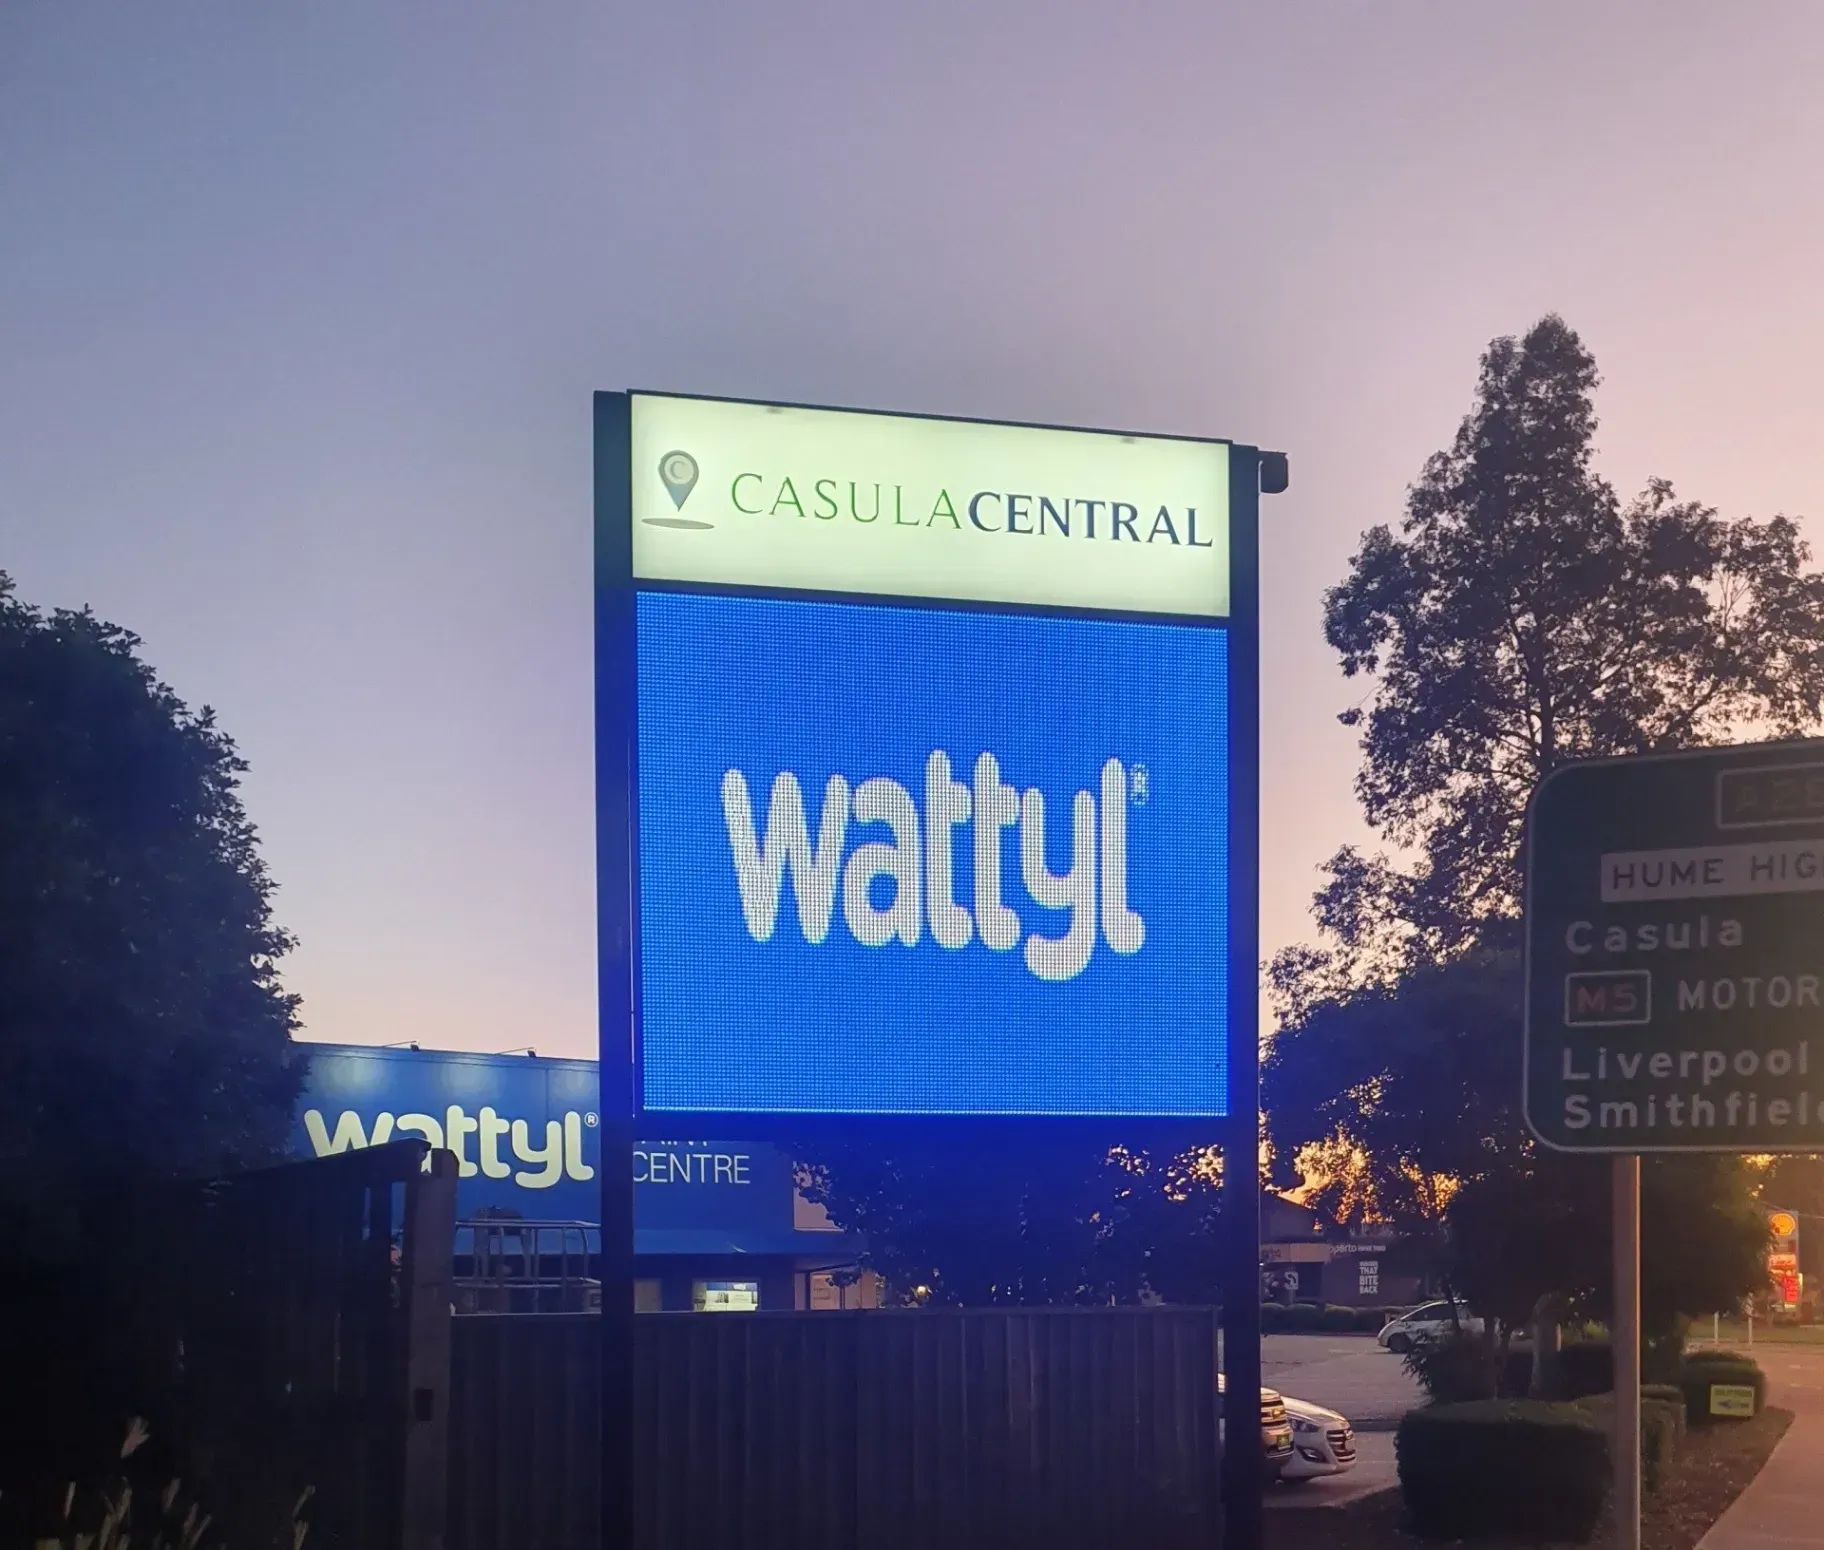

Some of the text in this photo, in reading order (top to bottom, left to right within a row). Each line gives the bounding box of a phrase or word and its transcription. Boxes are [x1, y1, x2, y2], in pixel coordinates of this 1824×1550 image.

[720, 749, 1146, 982] wattyl
[1613, 851, 1824, 891] HUME HIG
[1565, 915, 1744, 955] Casula
[1577, 983, 1638, 1013] M5
[1678, 974, 1821, 1011] MOTOR
[1563, 1040, 1809, 1085] Liverpool
[633, 1150, 751, 1185] CENTRE
[1359, 1275, 1379, 1285] BITE
